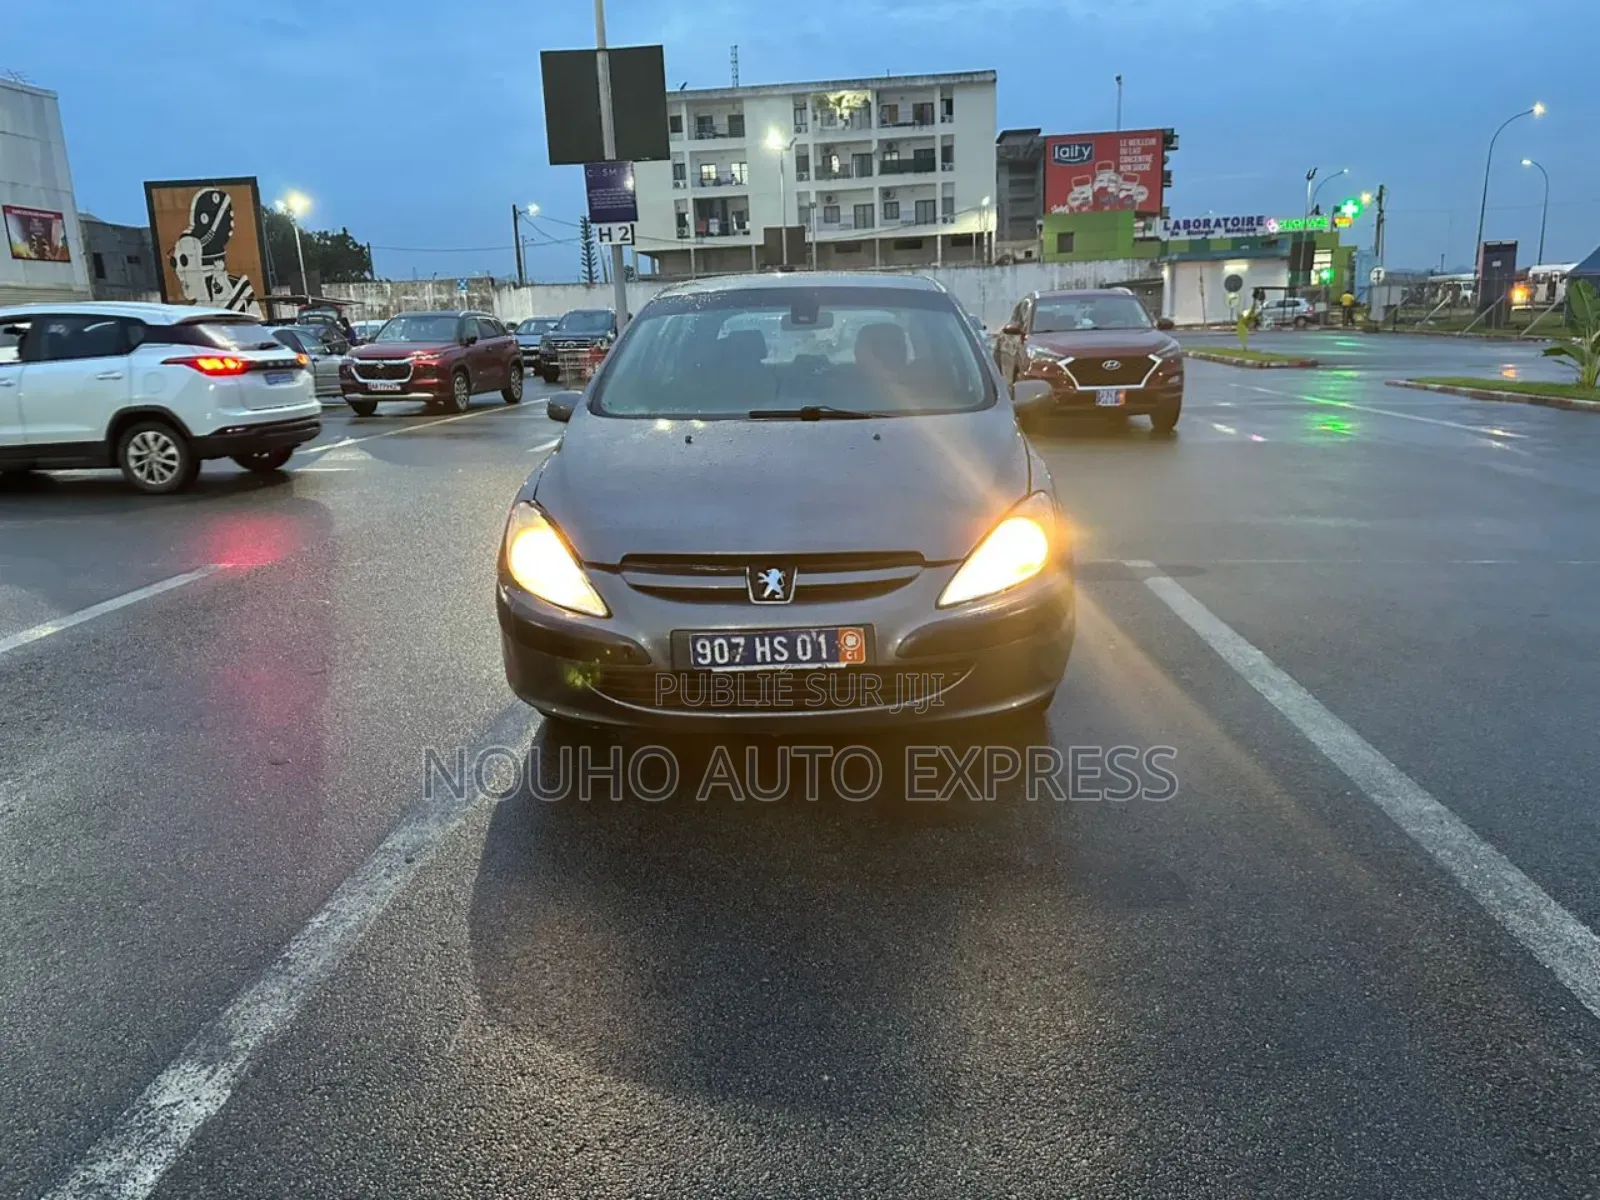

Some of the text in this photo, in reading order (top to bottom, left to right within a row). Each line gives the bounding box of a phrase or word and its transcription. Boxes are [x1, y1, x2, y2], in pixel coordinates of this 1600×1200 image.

[1164, 215, 1264, 231] LABORATOIRE
[696, 632, 827, 665] 907 HS 01
